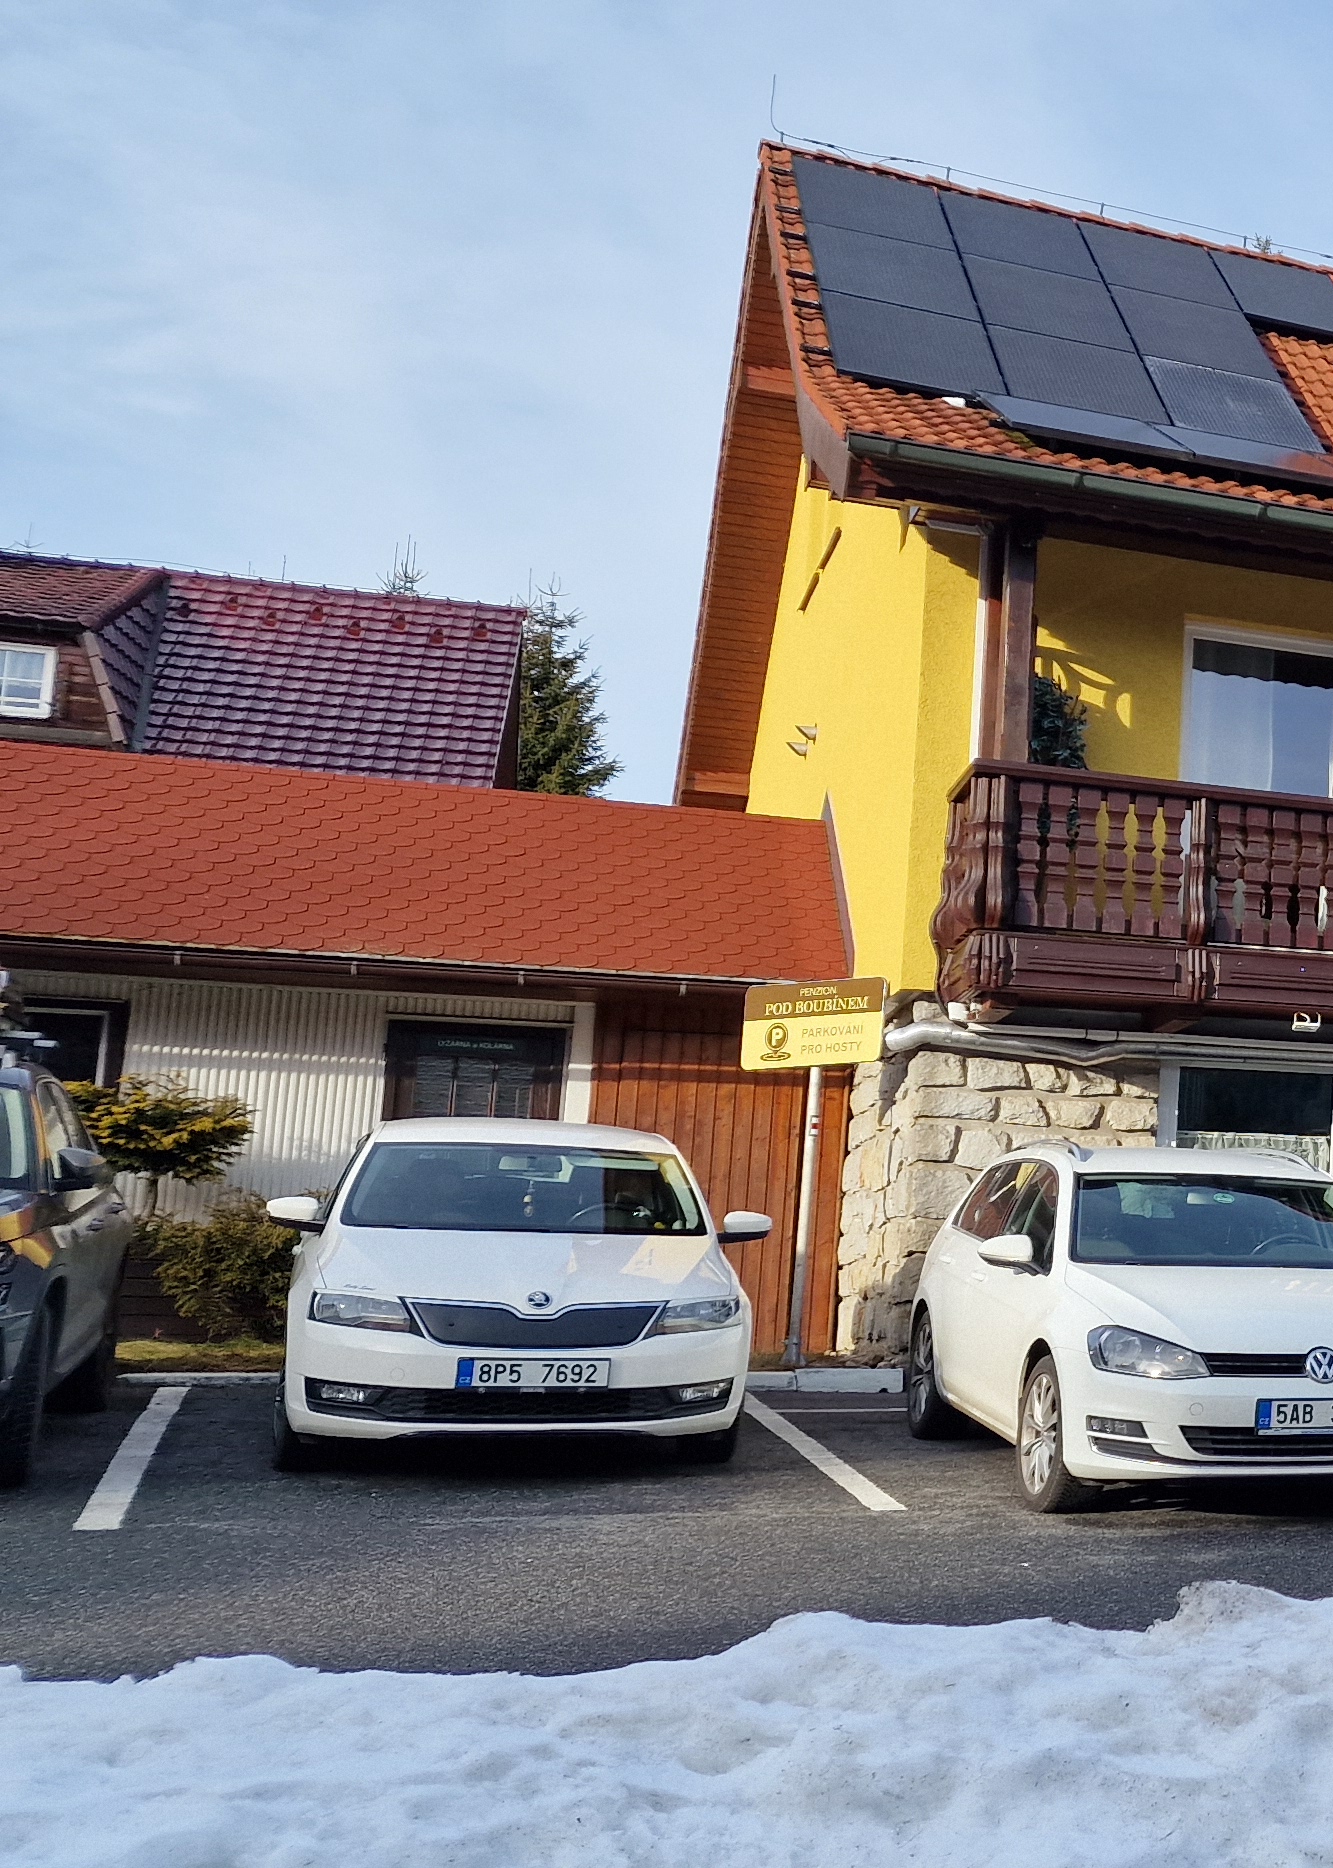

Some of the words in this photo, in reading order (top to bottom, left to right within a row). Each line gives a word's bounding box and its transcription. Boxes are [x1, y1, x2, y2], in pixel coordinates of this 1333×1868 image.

[800, 986, 837, 996] PENZION
[765, 1003, 792, 1016] POD
[795, 995, 869, 1014] BOUBÍNEM
[800, 1044, 823, 1054] PRO
[825, 1041, 862, 1052] HOSTY
[459, 1376, 471, 1384] CZ
[478, 1363, 523, 1384] 8P5
[540, 1363, 598, 1384] 7692
[1259, 1417, 1270, 1425] CZ
[1276, 1403, 1314, 1425] 5AB
